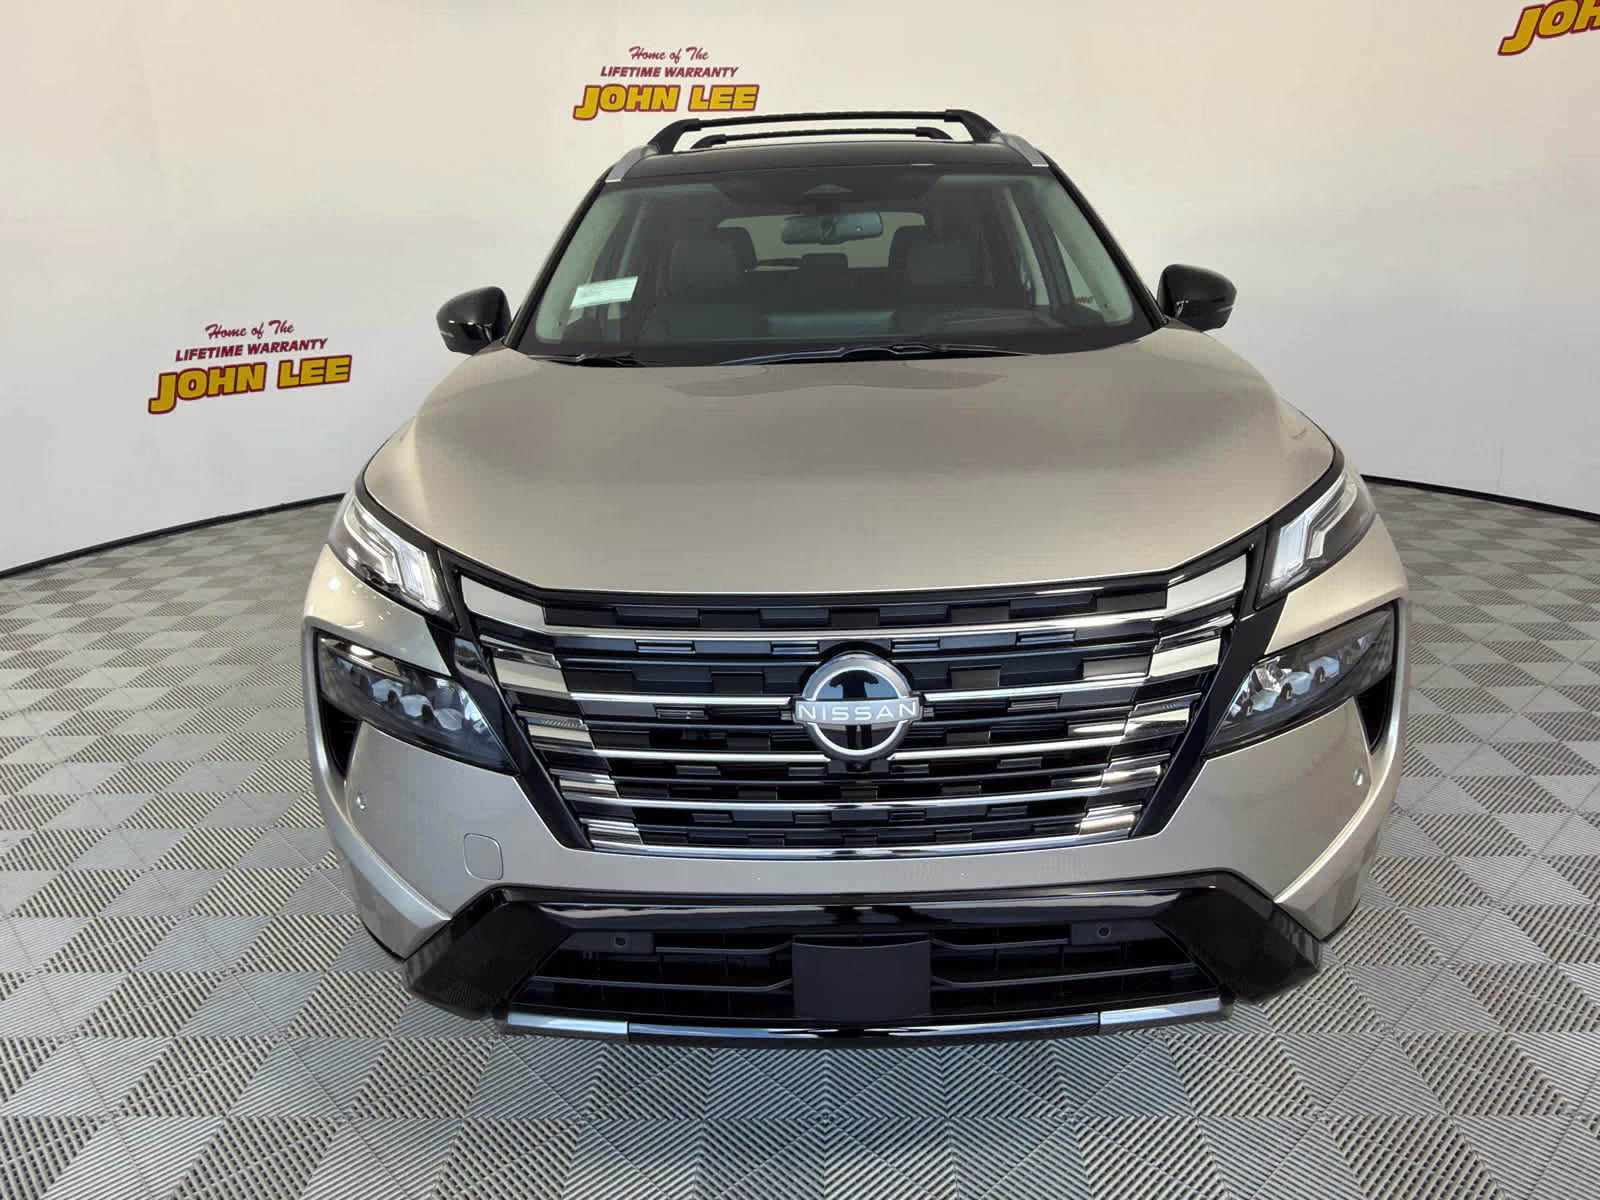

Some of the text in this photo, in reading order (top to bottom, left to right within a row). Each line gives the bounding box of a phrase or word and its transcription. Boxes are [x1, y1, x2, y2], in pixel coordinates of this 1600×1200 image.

[629, 46, 709, 64] Home of The
[600, 66, 738, 77] LIFETIME WARRANTY
[573, 84, 760, 120] JOHN LEE
[205, 319, 295, 339] Home of The
[175, 338, 328, 361] LIFETIME WARRANTY
[148, 355, 352, 414] JOHN LEE
[798, 701, 918, 721] NISSAN
